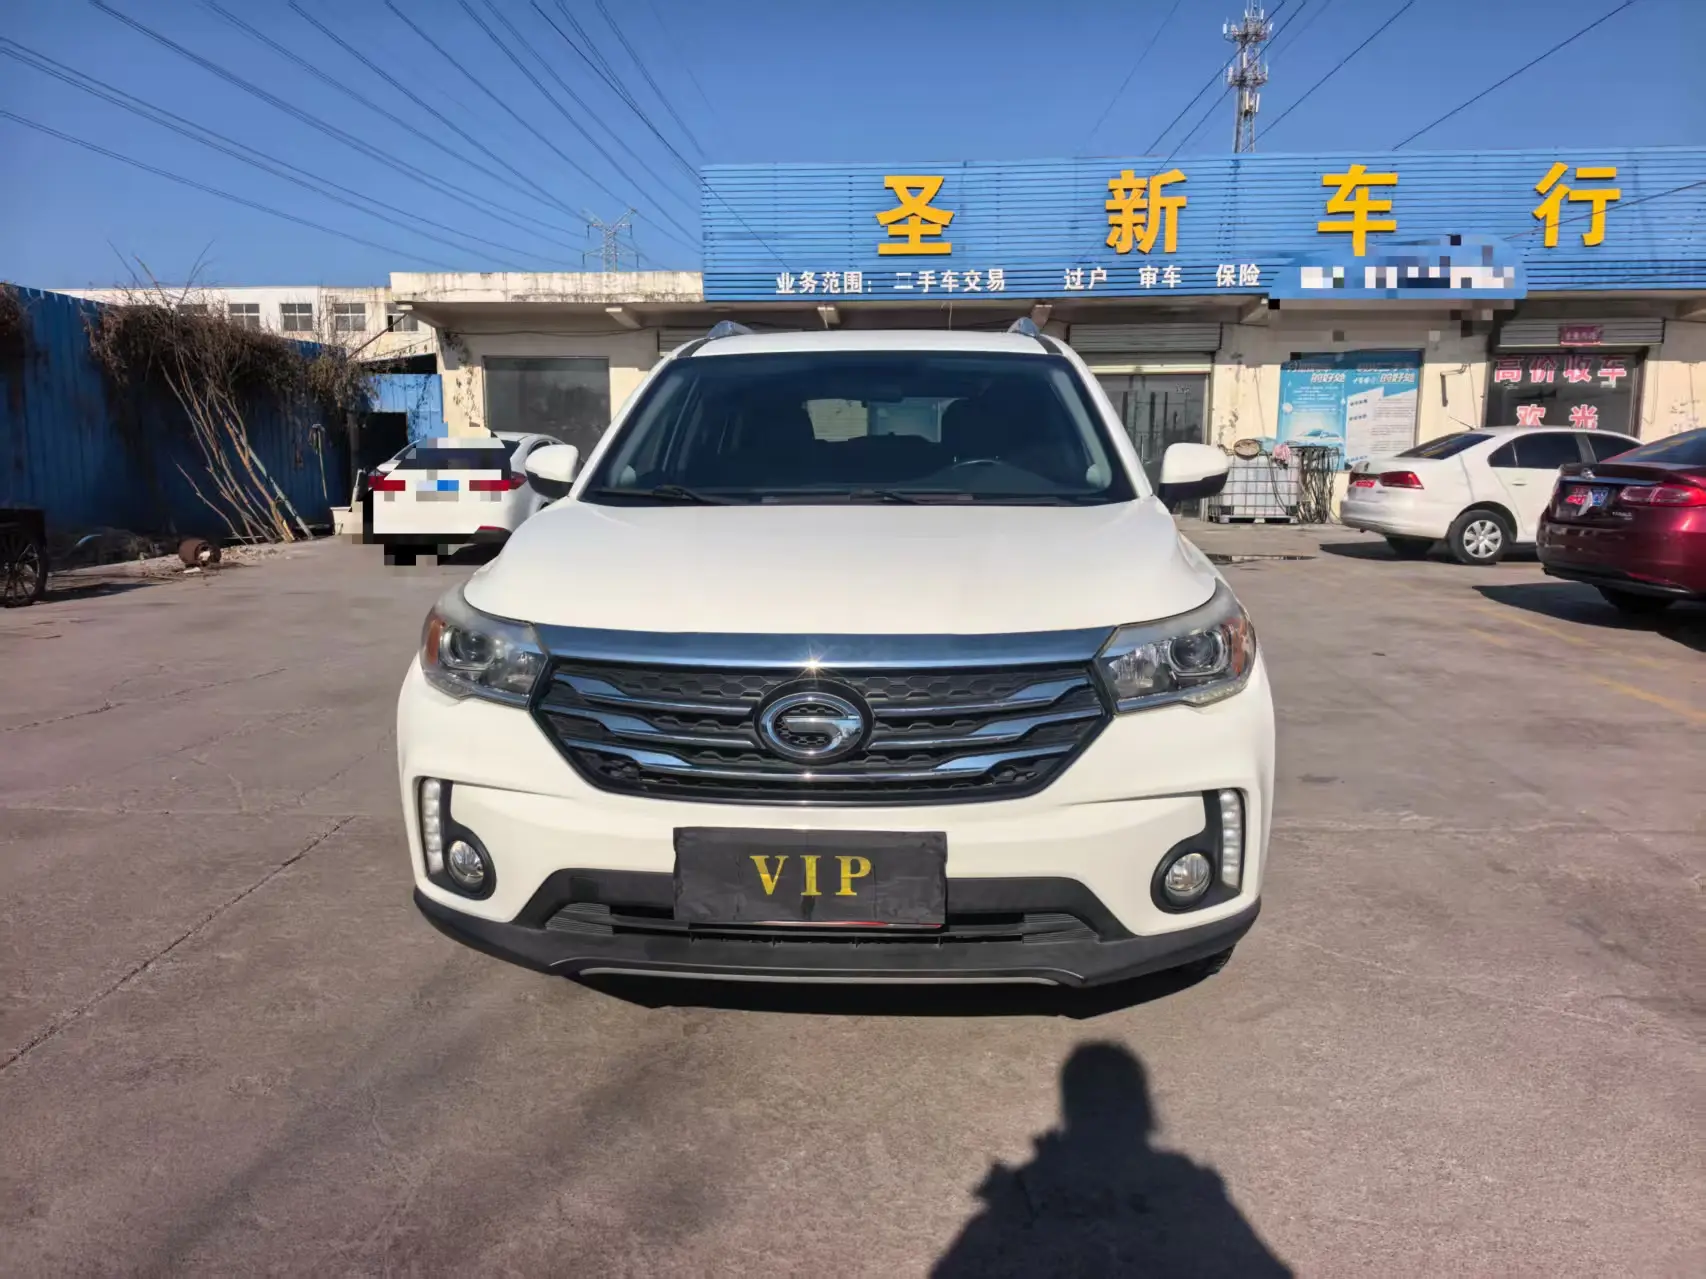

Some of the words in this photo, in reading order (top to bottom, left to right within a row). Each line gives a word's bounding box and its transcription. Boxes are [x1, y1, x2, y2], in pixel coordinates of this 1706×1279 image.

[875, 162, 1621, 257] 圣新车行
[893, 268, 1005, 293] 二手车交易
[1064, 266, 1107, 291] 过户
[1138, 265, 1183, 289] 审车
[1215, 263, 1261, 288] 保险
[1494, 354, 1627, 385] 高价收车
[749, 855, 872, 896] VIP
